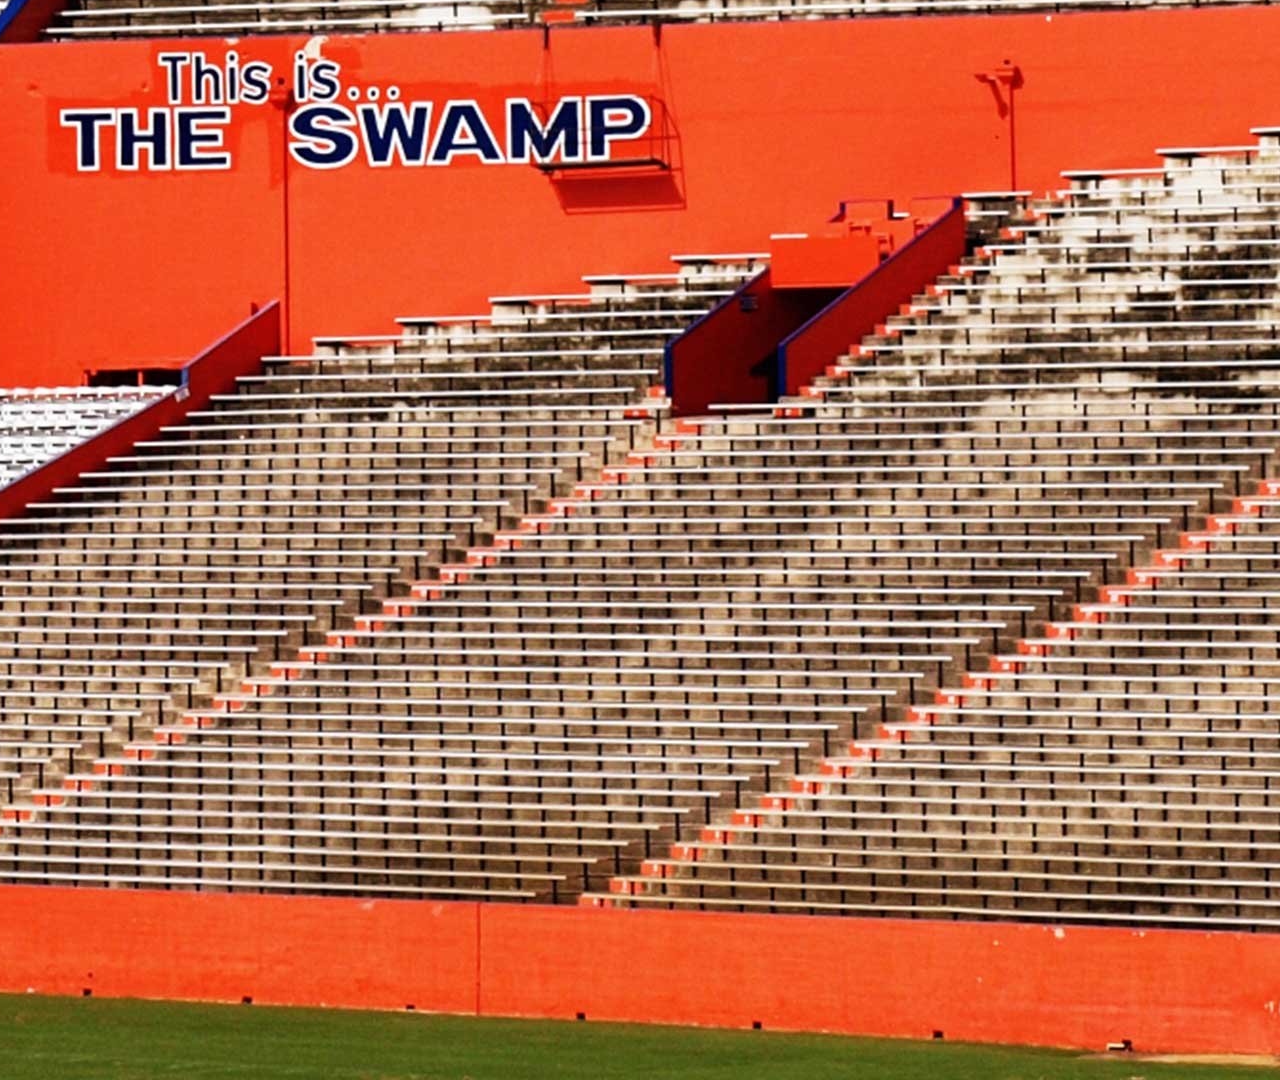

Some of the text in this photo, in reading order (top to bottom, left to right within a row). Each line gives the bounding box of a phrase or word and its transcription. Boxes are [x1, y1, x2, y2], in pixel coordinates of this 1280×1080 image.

[159, 51, 271, 103] This
[60, 94, 651, 171] THE SWAMP
